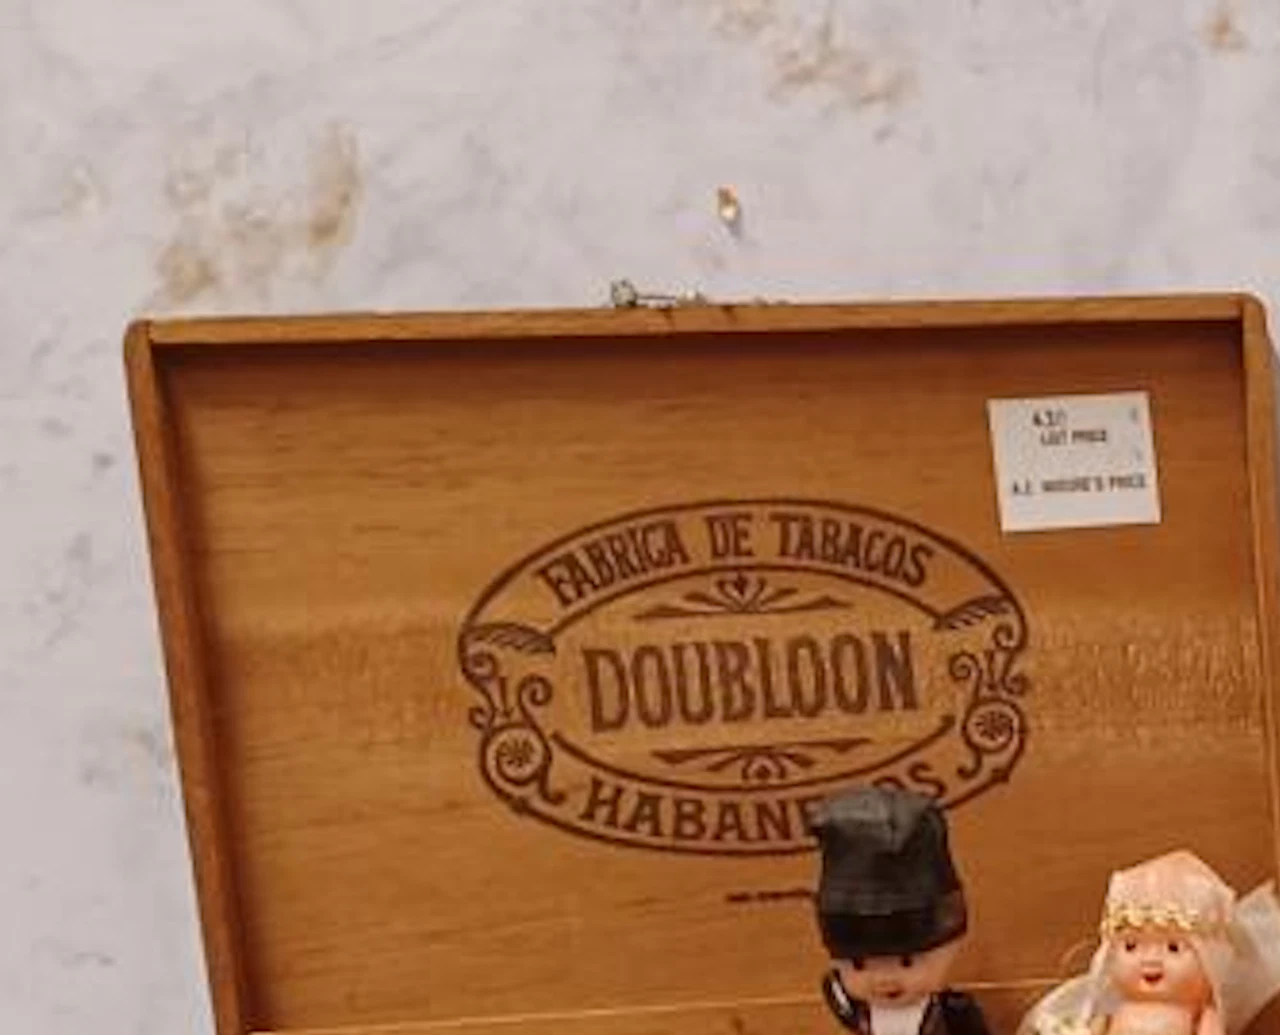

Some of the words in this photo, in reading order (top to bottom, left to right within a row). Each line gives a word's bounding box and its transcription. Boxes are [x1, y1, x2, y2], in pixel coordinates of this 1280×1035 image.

[537, 518, 691, 606] FABRICA
[704, 510, 756, 559] DE
[768, 511, 935, 588] TABACOS
[582, 629, 919, 732] DOUBLOON
